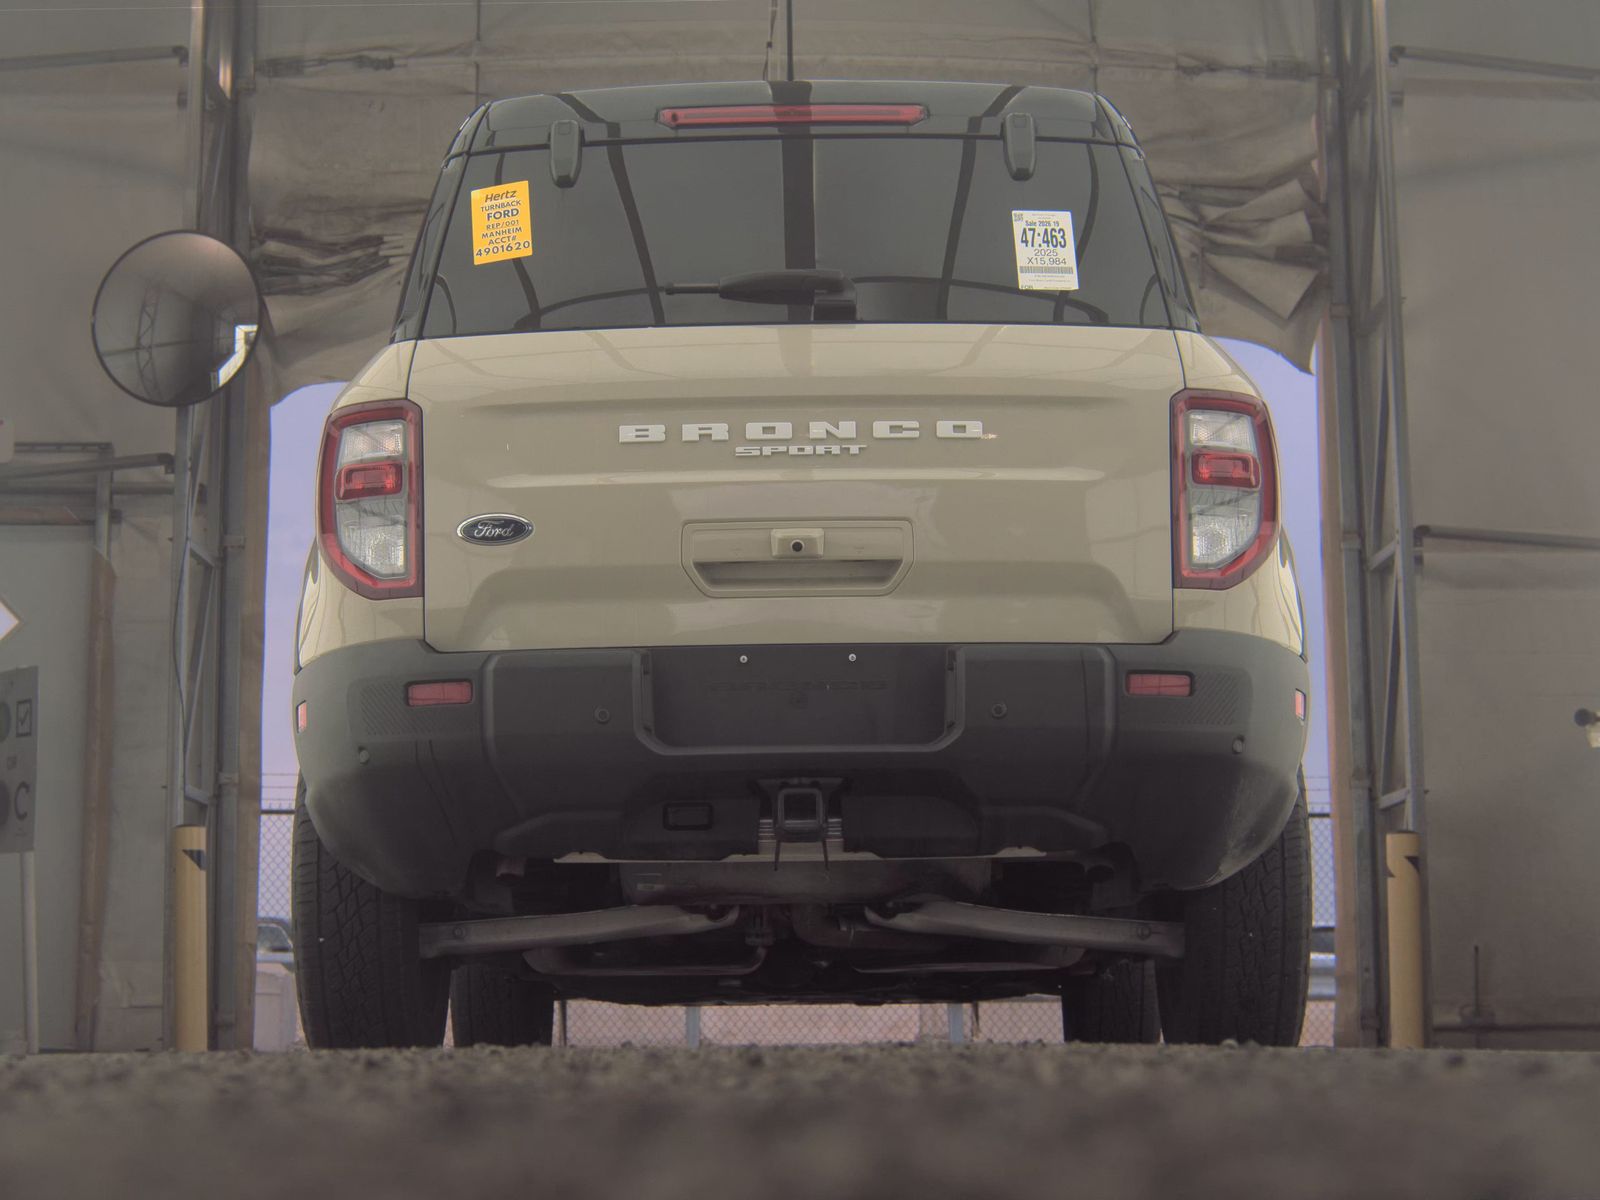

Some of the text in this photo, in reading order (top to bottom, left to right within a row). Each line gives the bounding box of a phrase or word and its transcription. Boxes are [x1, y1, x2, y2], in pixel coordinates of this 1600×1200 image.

[485, 191, 517, 202] Hertz
[481, 200, 521, 212] TURNBACK
[487, 208, 519, 220] FORD
[486, 220, 519, 230] REP/001
[481, 227, 522, 239] MANHEIM
[1021, 228, 1066, 248] 47:463
[488, 235, 517, 246] ACCT#
[476, 241, 530, 256] 4901620
[1034, 249, 1058, 257] 2025
[1027, 257, 1067, 266] X15,984
[618, 420, 983, 443] BRONCO
[735, 444, 867, 457] SPORT
[474, 520, 514, 537] Ford
